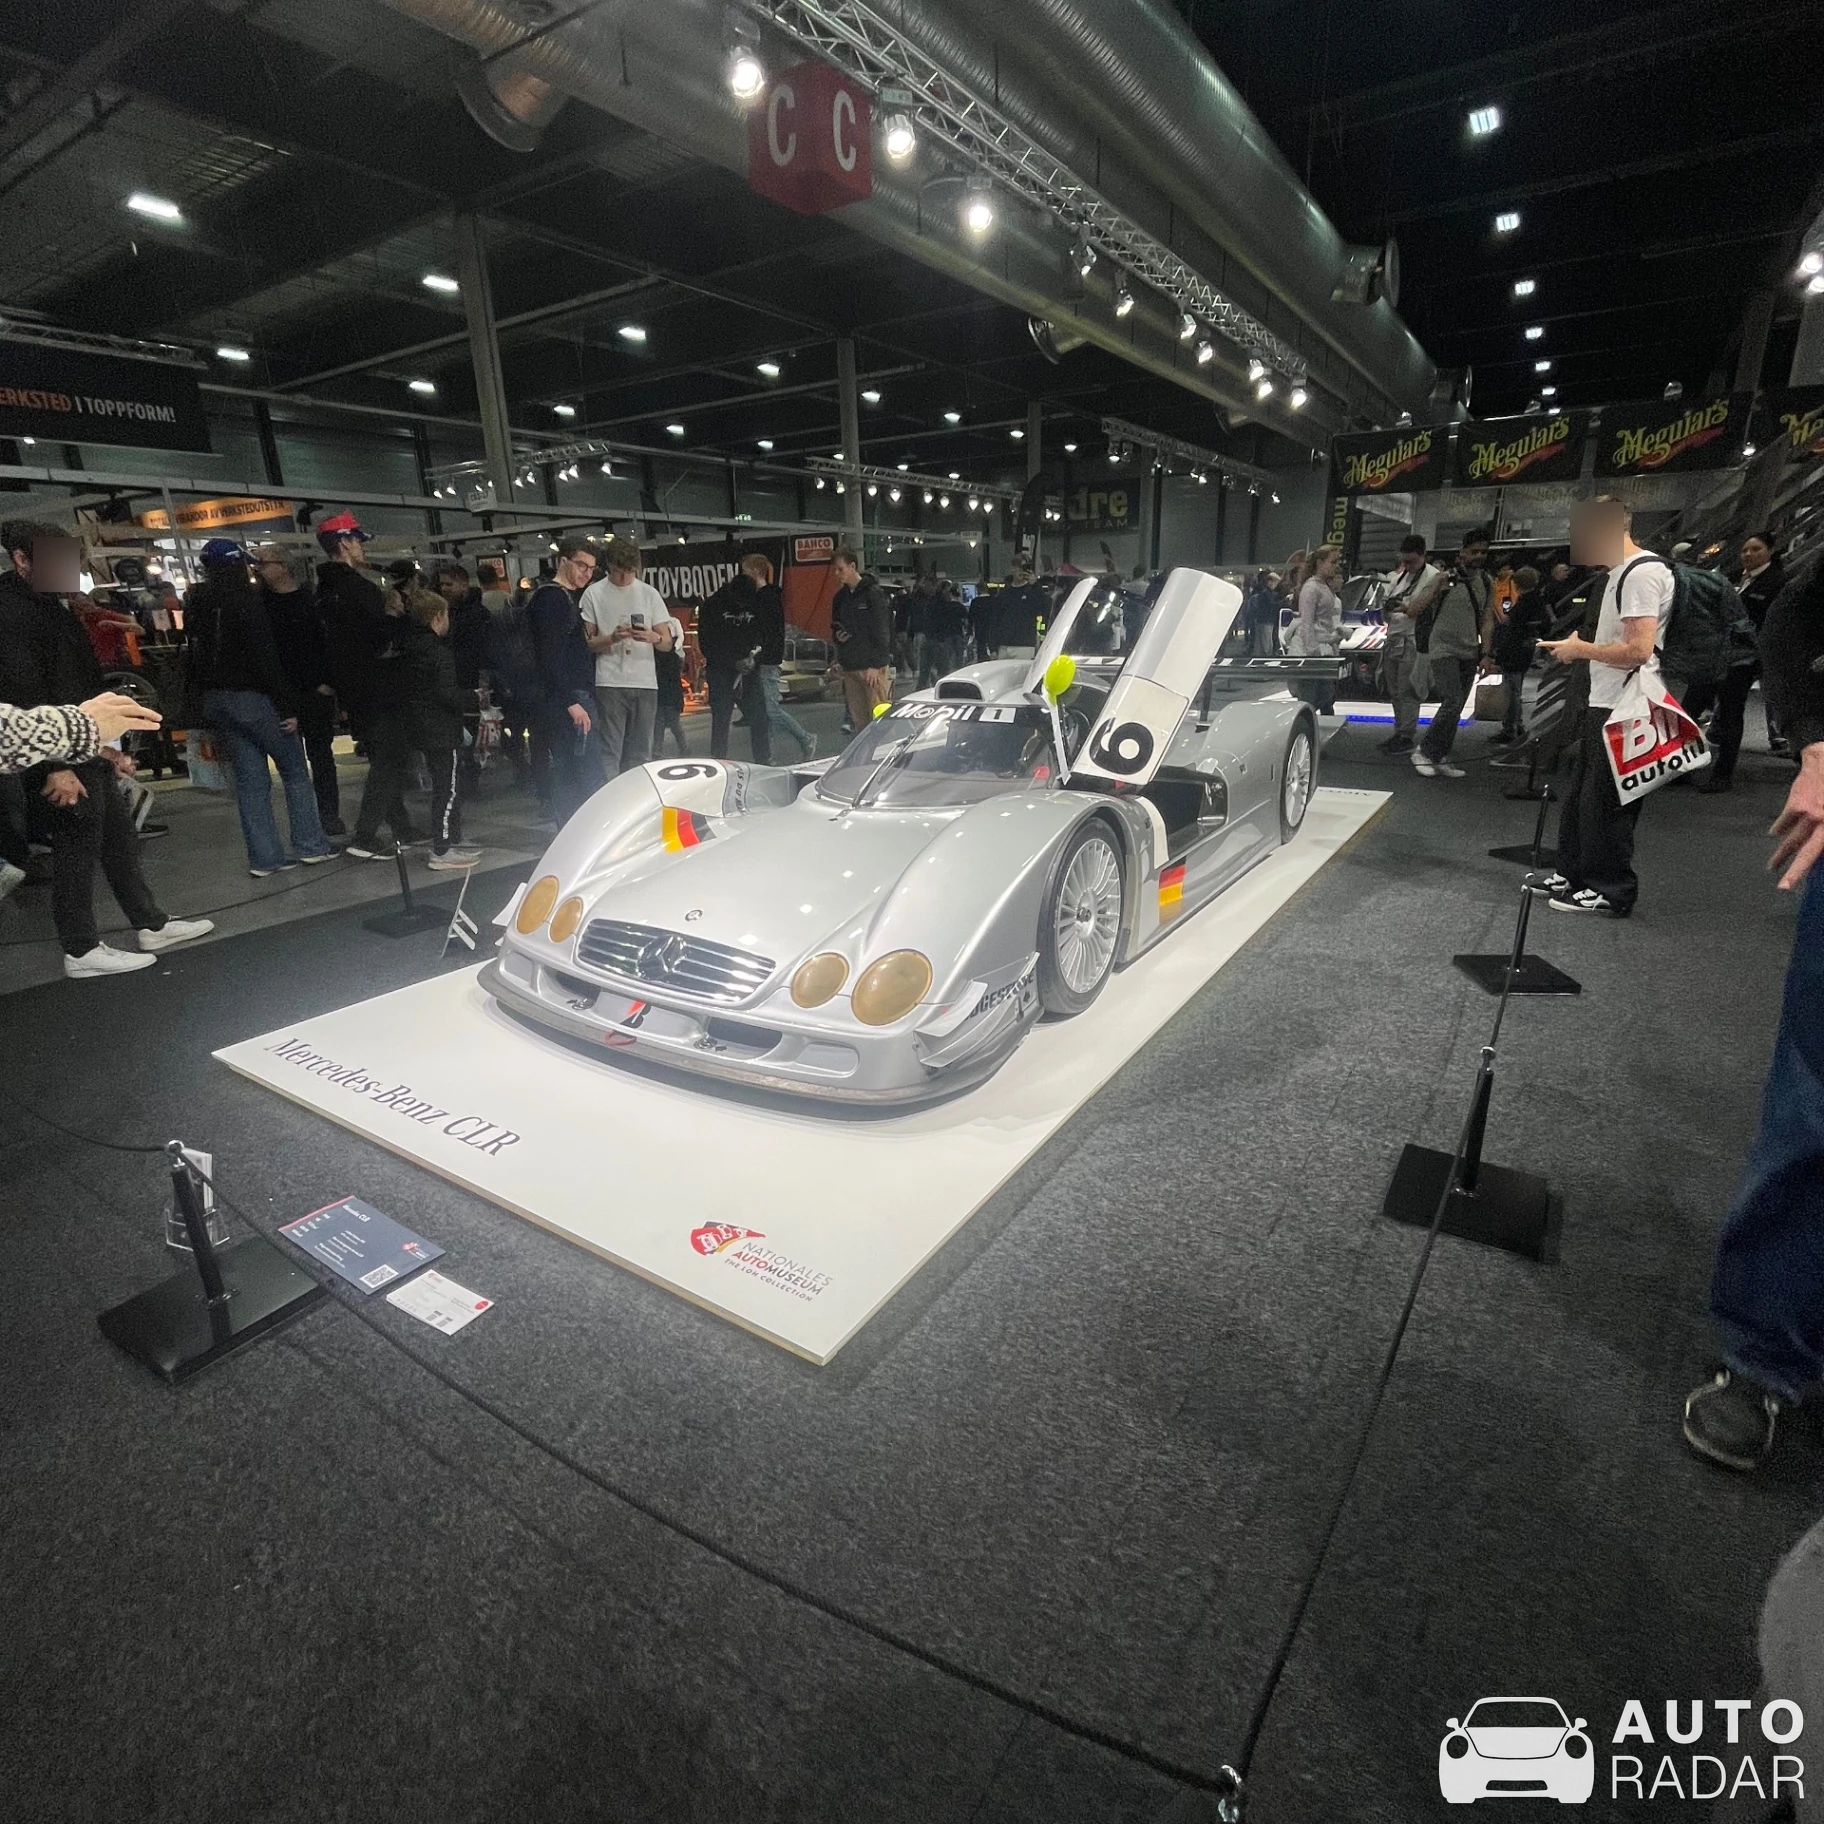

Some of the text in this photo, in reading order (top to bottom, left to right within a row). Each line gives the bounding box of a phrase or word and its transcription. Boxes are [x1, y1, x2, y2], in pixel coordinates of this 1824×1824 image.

[768, 84, 796, 166] C
[833, 91, 856, 171] C
[83, 397, 176, 423] TOPPFORM!
[1612, 398, 1730, 469] Meguiar's
[1343, 430, 1433, 489] Meguiar's
[1468, 416, 1571, 480] Meguiar's
[797, 538, 831, 549] BAHCO
[1326, 497, 1348, 549] meg
[890, 703, 976, 721] Mobil
[263, 1038, 521, 1157] Mercedes-Benz CLR
[724, 1258, 814, 1302] THE LOH COLLECTION
[732, 1250, 824, 1295] AUTOMUSEUM
[742, 1242, 833, 1287] NATIONALES
